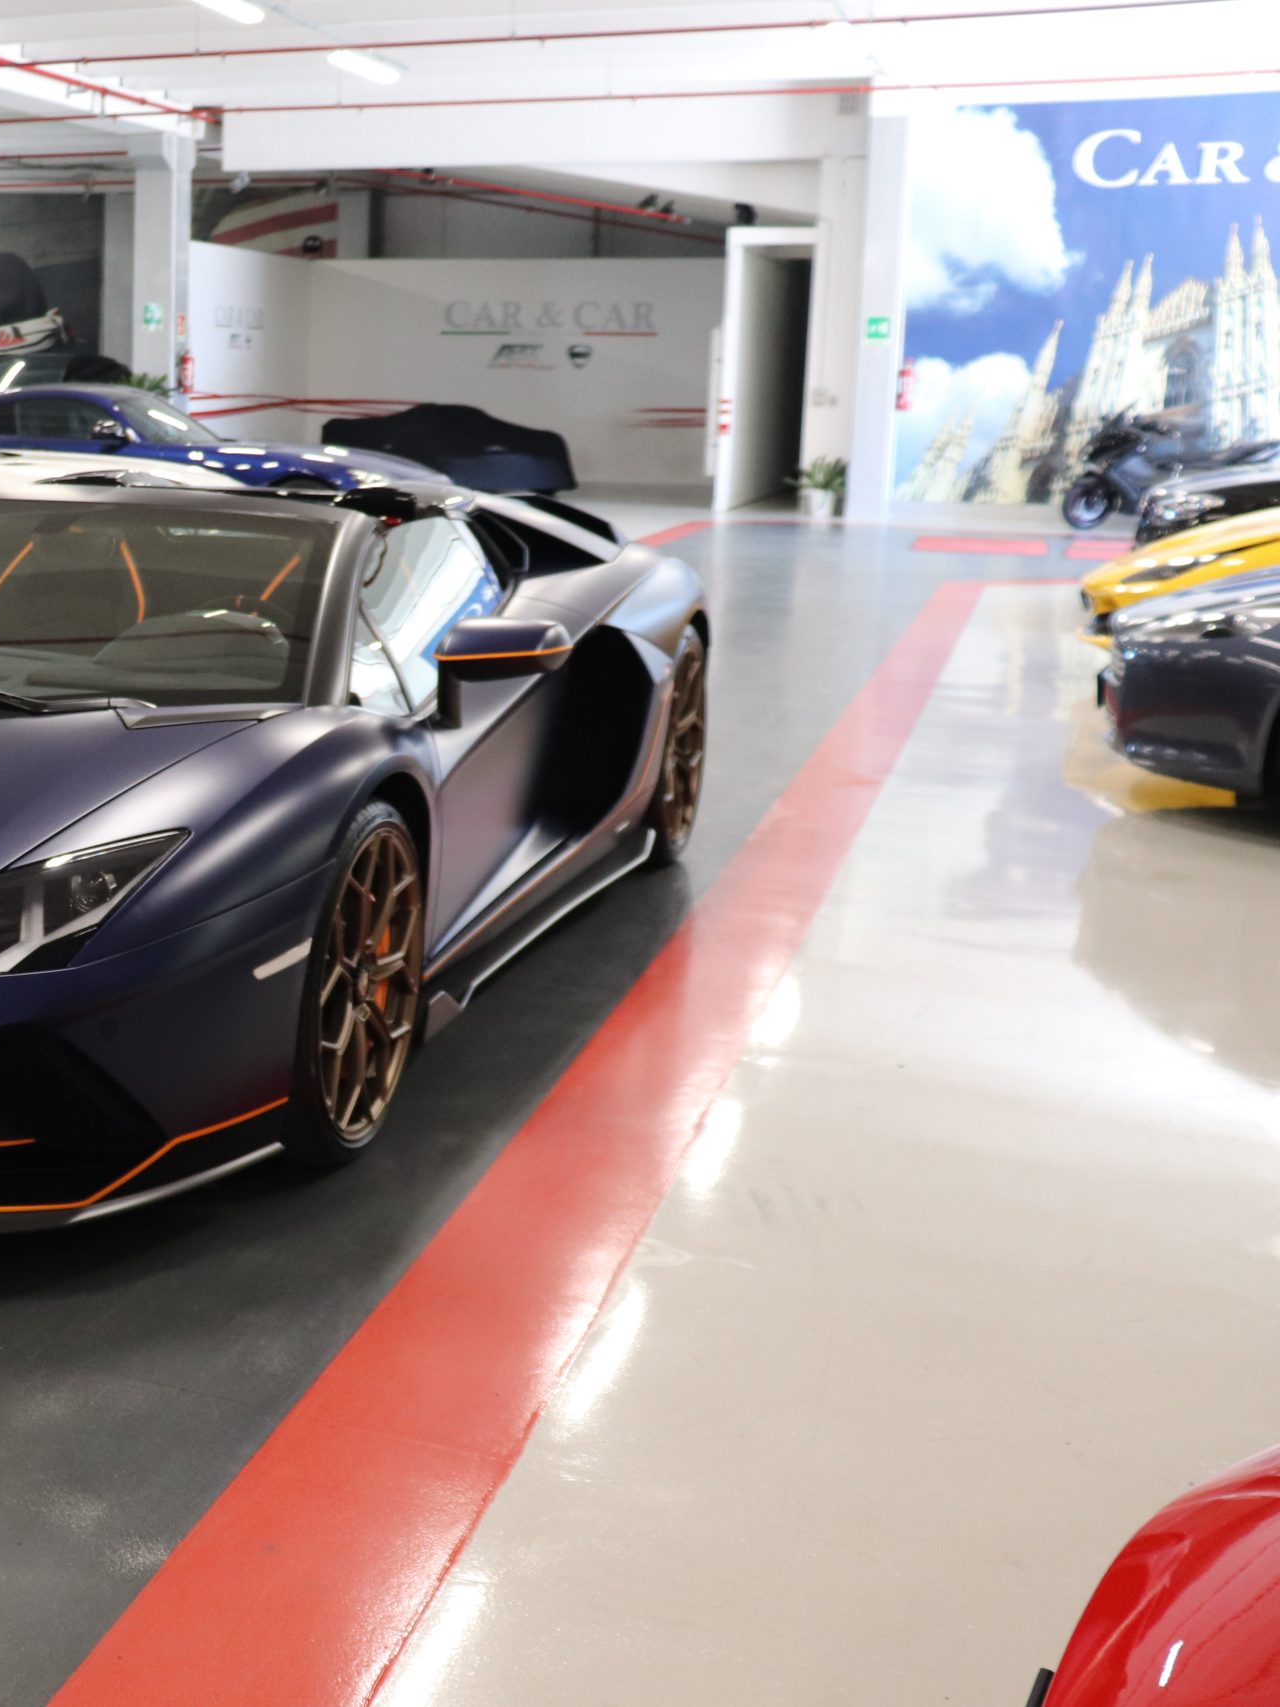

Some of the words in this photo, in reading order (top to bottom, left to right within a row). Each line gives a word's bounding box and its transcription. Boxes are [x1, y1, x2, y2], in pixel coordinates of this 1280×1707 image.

[1072, 128, 1251, 189] CAR
[444, 301, 523, 330] CAR
[536, 301, 565, 329] &
[573, 301, 656, 331] CAR
